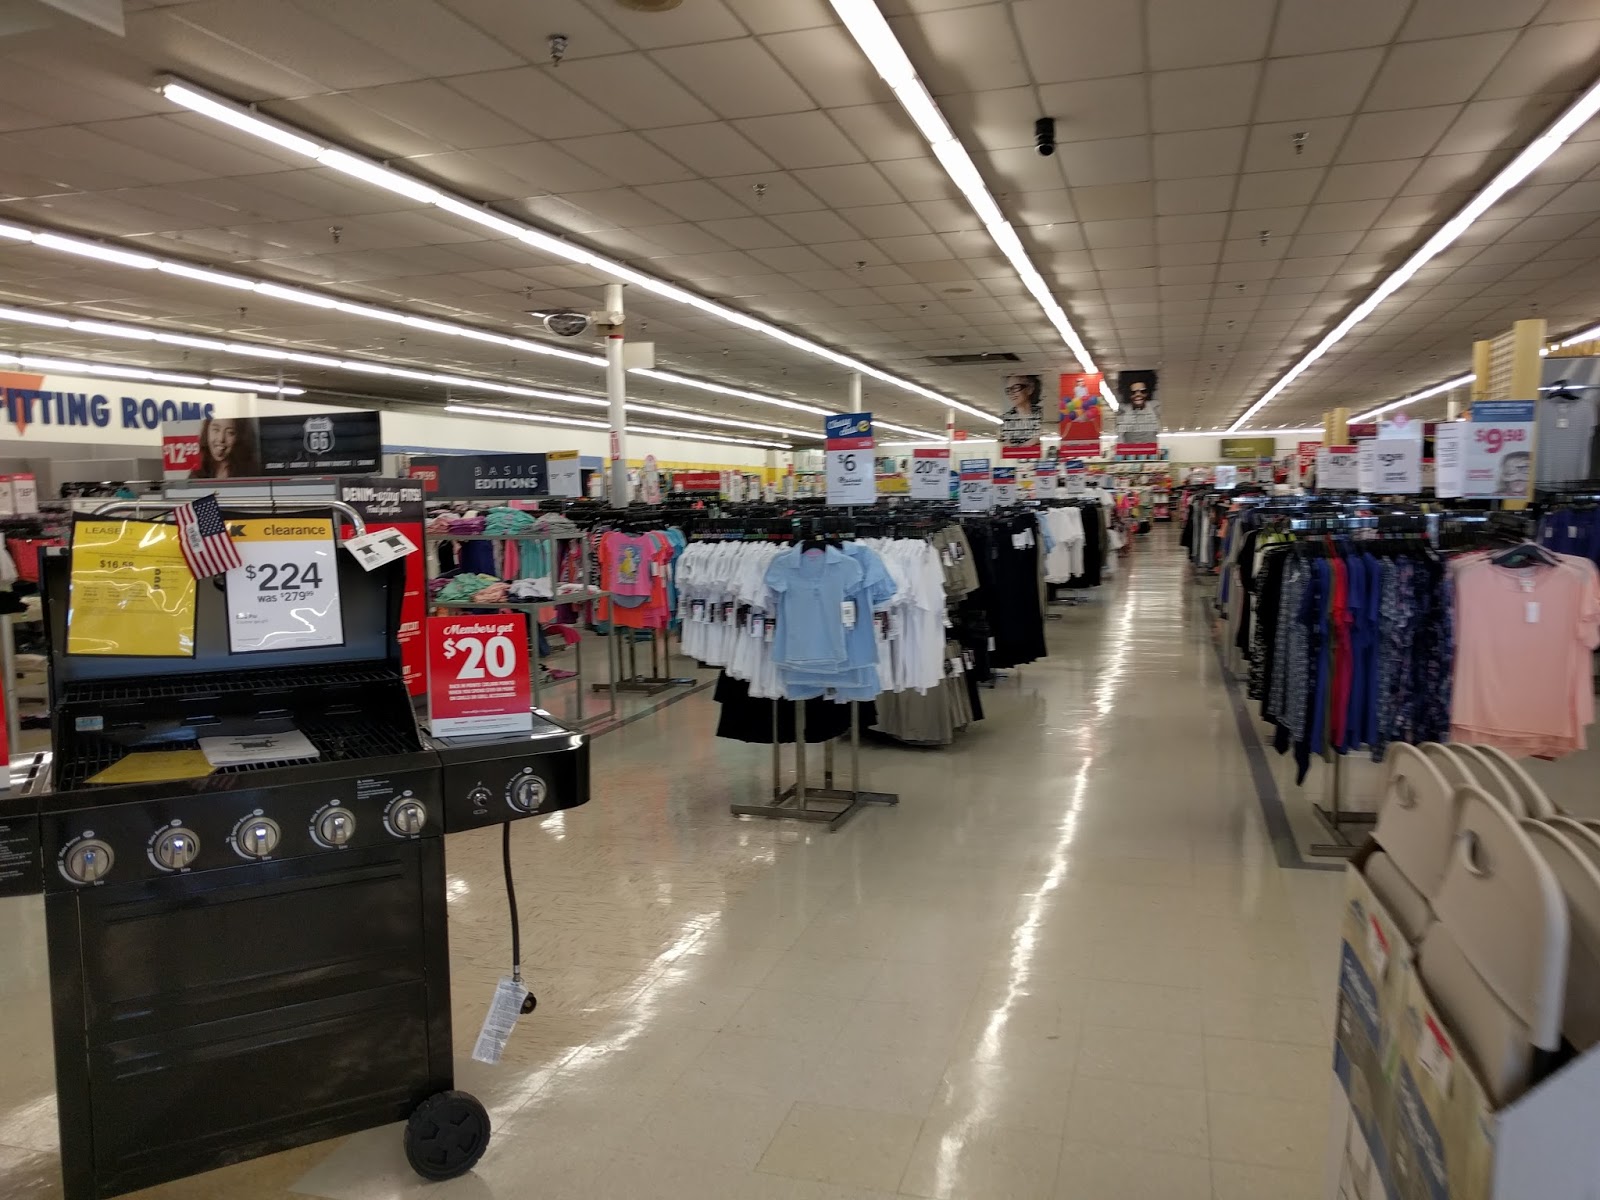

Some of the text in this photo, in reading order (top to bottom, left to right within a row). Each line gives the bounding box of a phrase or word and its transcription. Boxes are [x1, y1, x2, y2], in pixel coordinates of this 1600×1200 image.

[309, 432, 329, 450] 66
[837, 454, 857, 472] $6
[914, 460, 939, 474] 20%
[474, 464, 539, 476] BASIC
[474, 478, 539, 490] EDITIONS
[85, 527, 120, 535] LEASE
[263, 525, 326, 535] clearance
[245, 562, 323, 591] $224
[443, 623, 515, 636] Members get
[443, 636, 516, 680] $20
